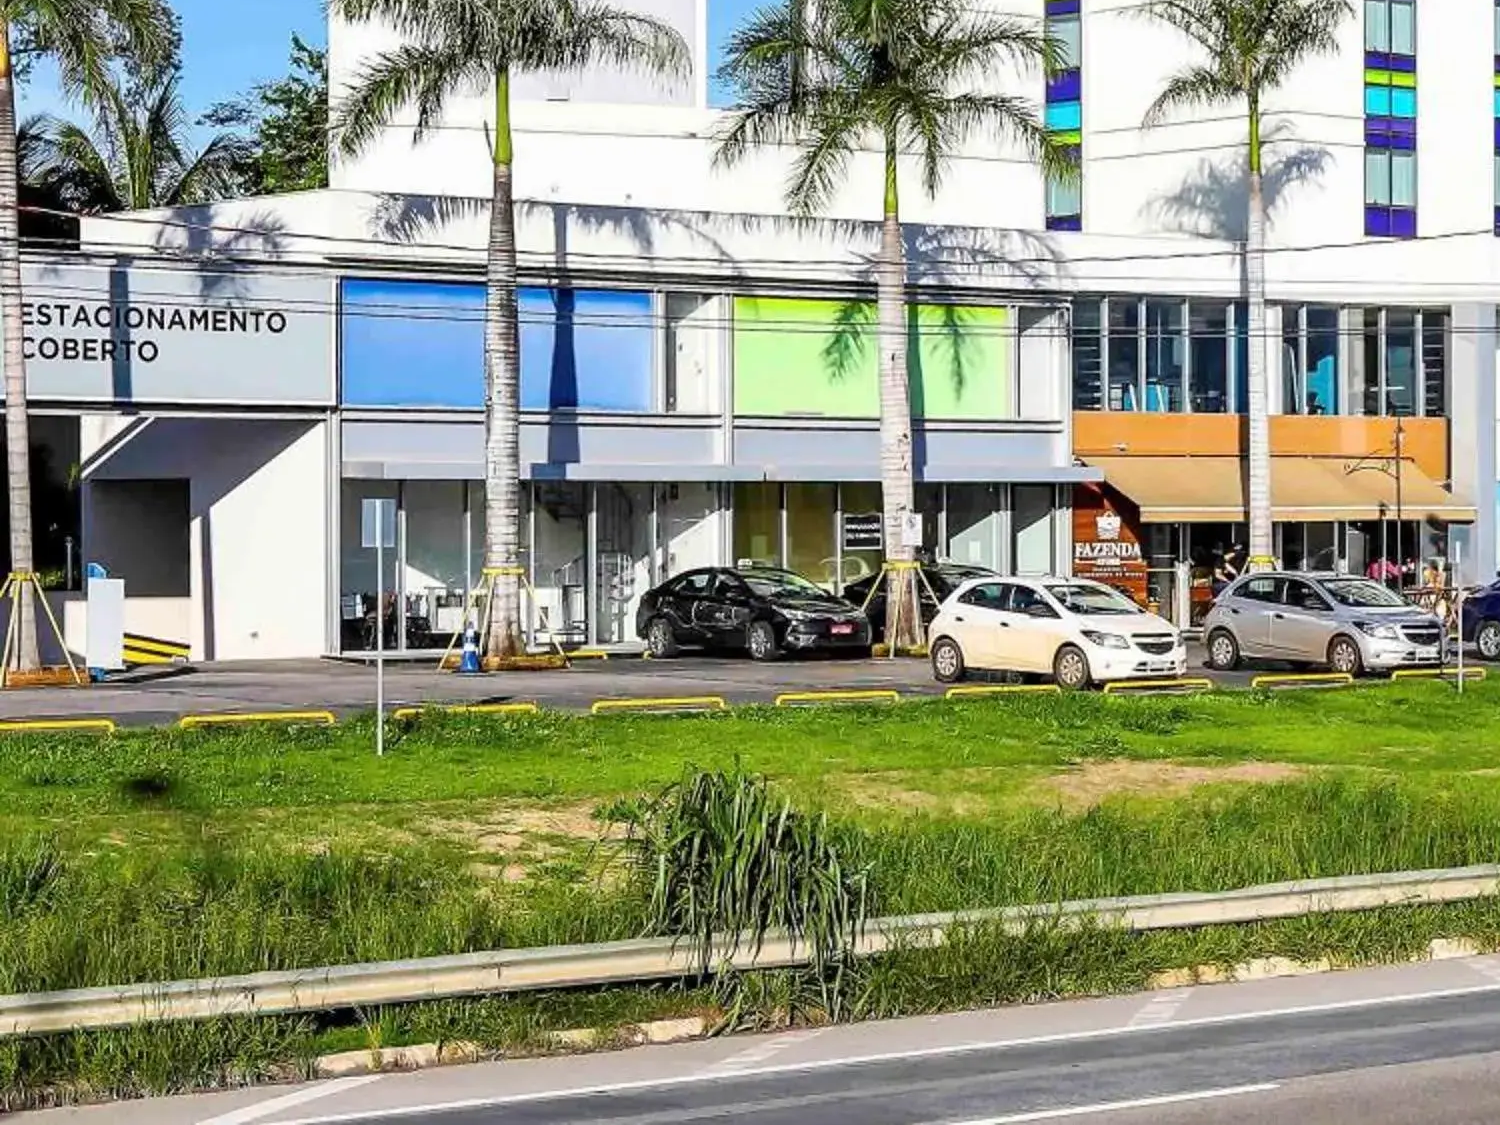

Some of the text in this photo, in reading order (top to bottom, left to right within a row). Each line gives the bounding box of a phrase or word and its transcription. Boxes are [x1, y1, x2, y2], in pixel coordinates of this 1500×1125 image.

[21, 303, 287, 334] ESTACIONAMENTO
[22, 337, 159, 363] COBERTO
[1075, 542, 1141, 557] FAZENDA
